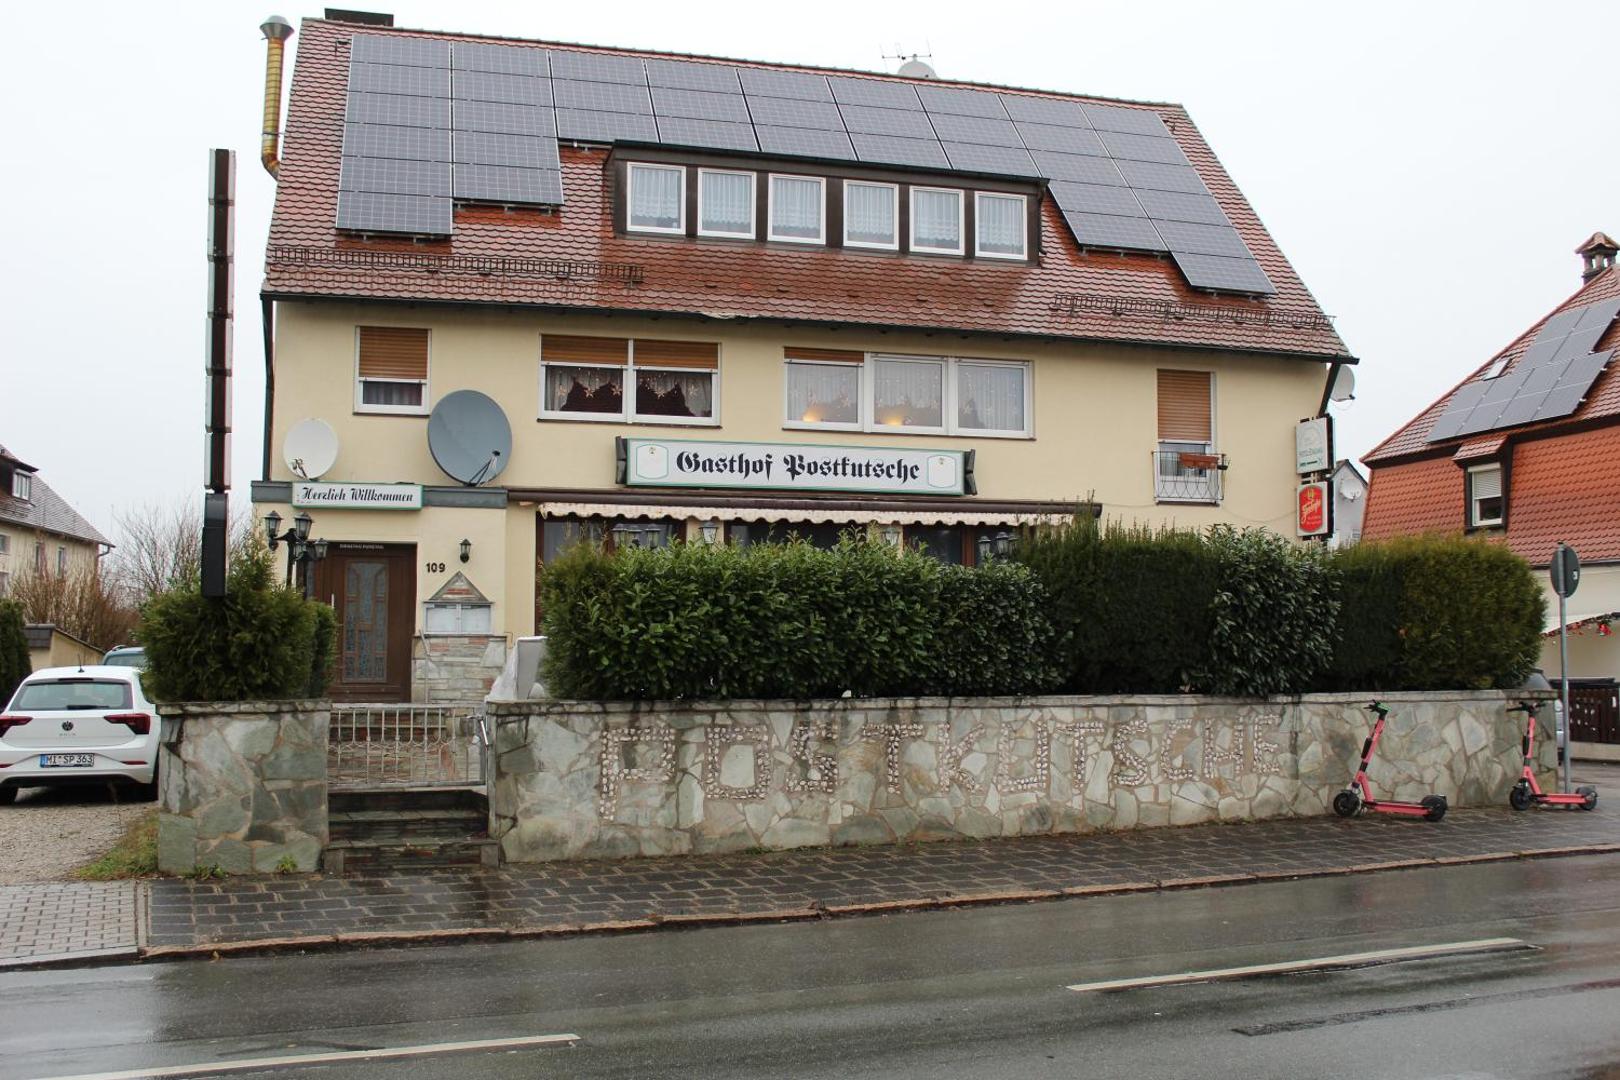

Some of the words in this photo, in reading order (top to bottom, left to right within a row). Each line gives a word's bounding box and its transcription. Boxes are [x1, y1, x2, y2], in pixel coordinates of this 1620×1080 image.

[676, 451, 773, 480] Gasthof
[783, 454, 920, 484] Postkutsche
[302, 487, 346, 500] Herzlich
[350, 488, 414, 502] Willkommen
[426, 562, 446, 573] 109
